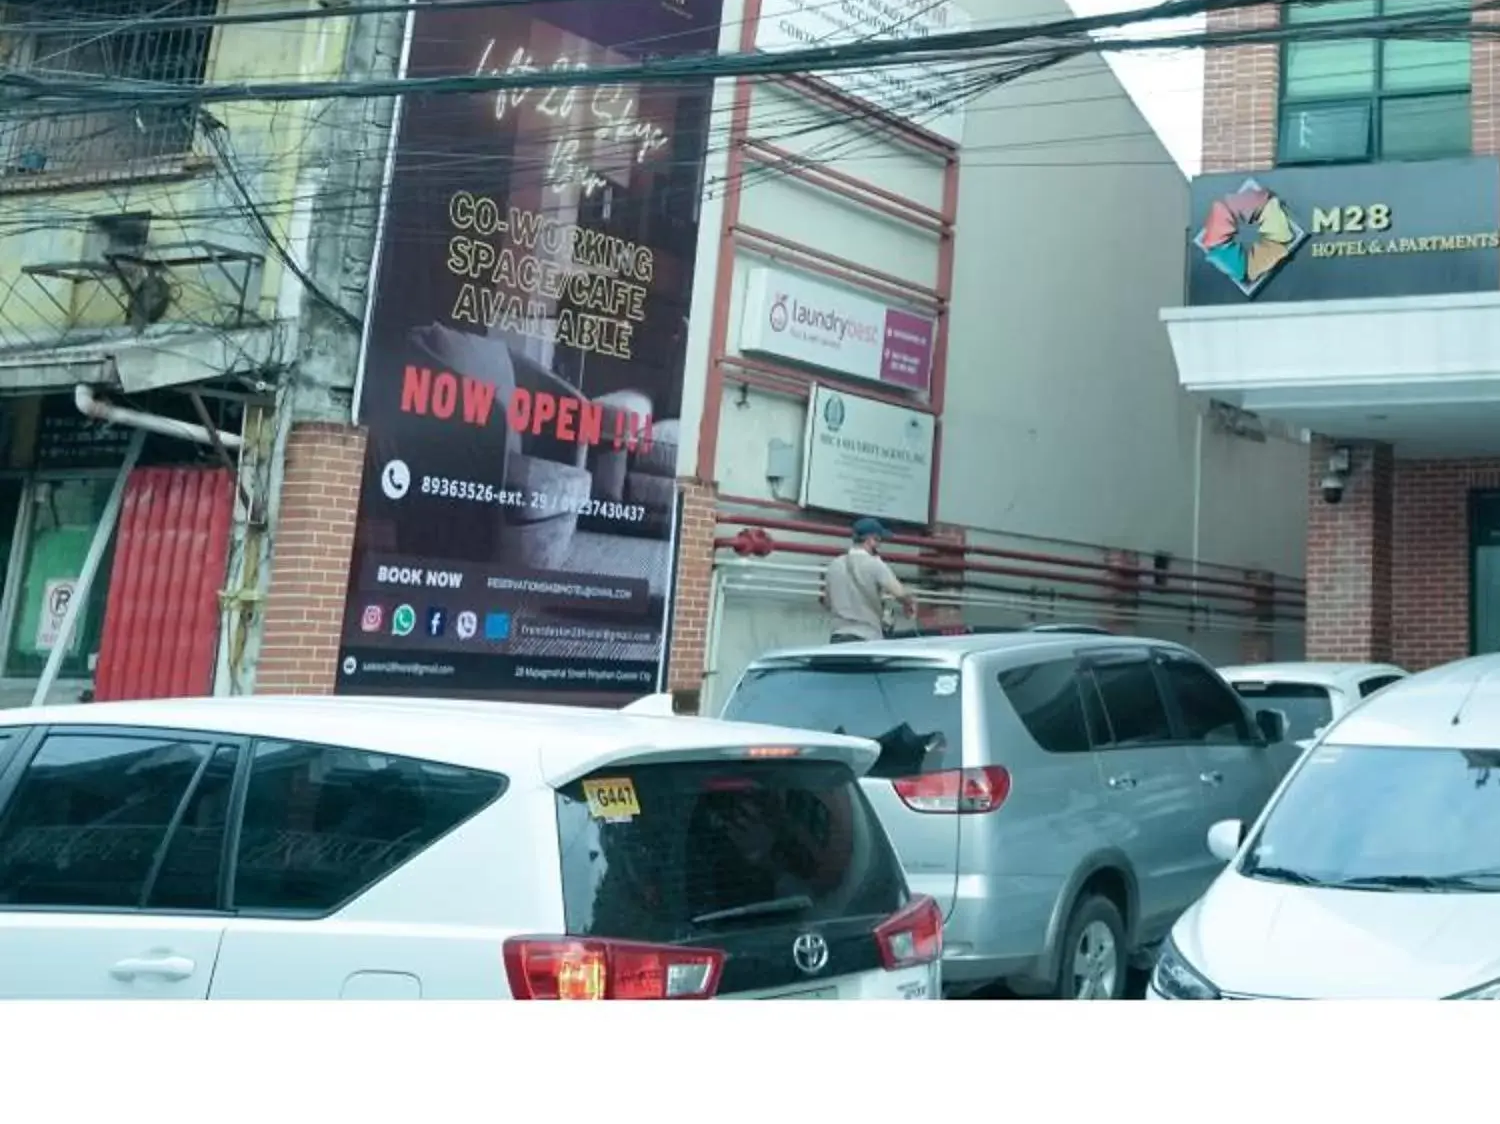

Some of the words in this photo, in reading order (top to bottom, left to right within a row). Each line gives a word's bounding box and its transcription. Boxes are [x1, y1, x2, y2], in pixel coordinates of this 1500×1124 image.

[450, 190, 653, 282] CO-WORKING
[1312, 203, 1391, 234] M28
[1312, 238, 1366, 258] HOTEL
[1368, 240, 1382, 255] &
[1387, 230, 1500, 254] APARTMENTS
[448, 236, 647, 321] SPACE/CAFE
[452, 284, 634, 359] AVAILABLE
[400, 365, 497, 427] NOW
[506, 387, 602, 446] OPEN
[377, 565, 424, 586] BOOK
[425, 569, 464, 589] NOW
